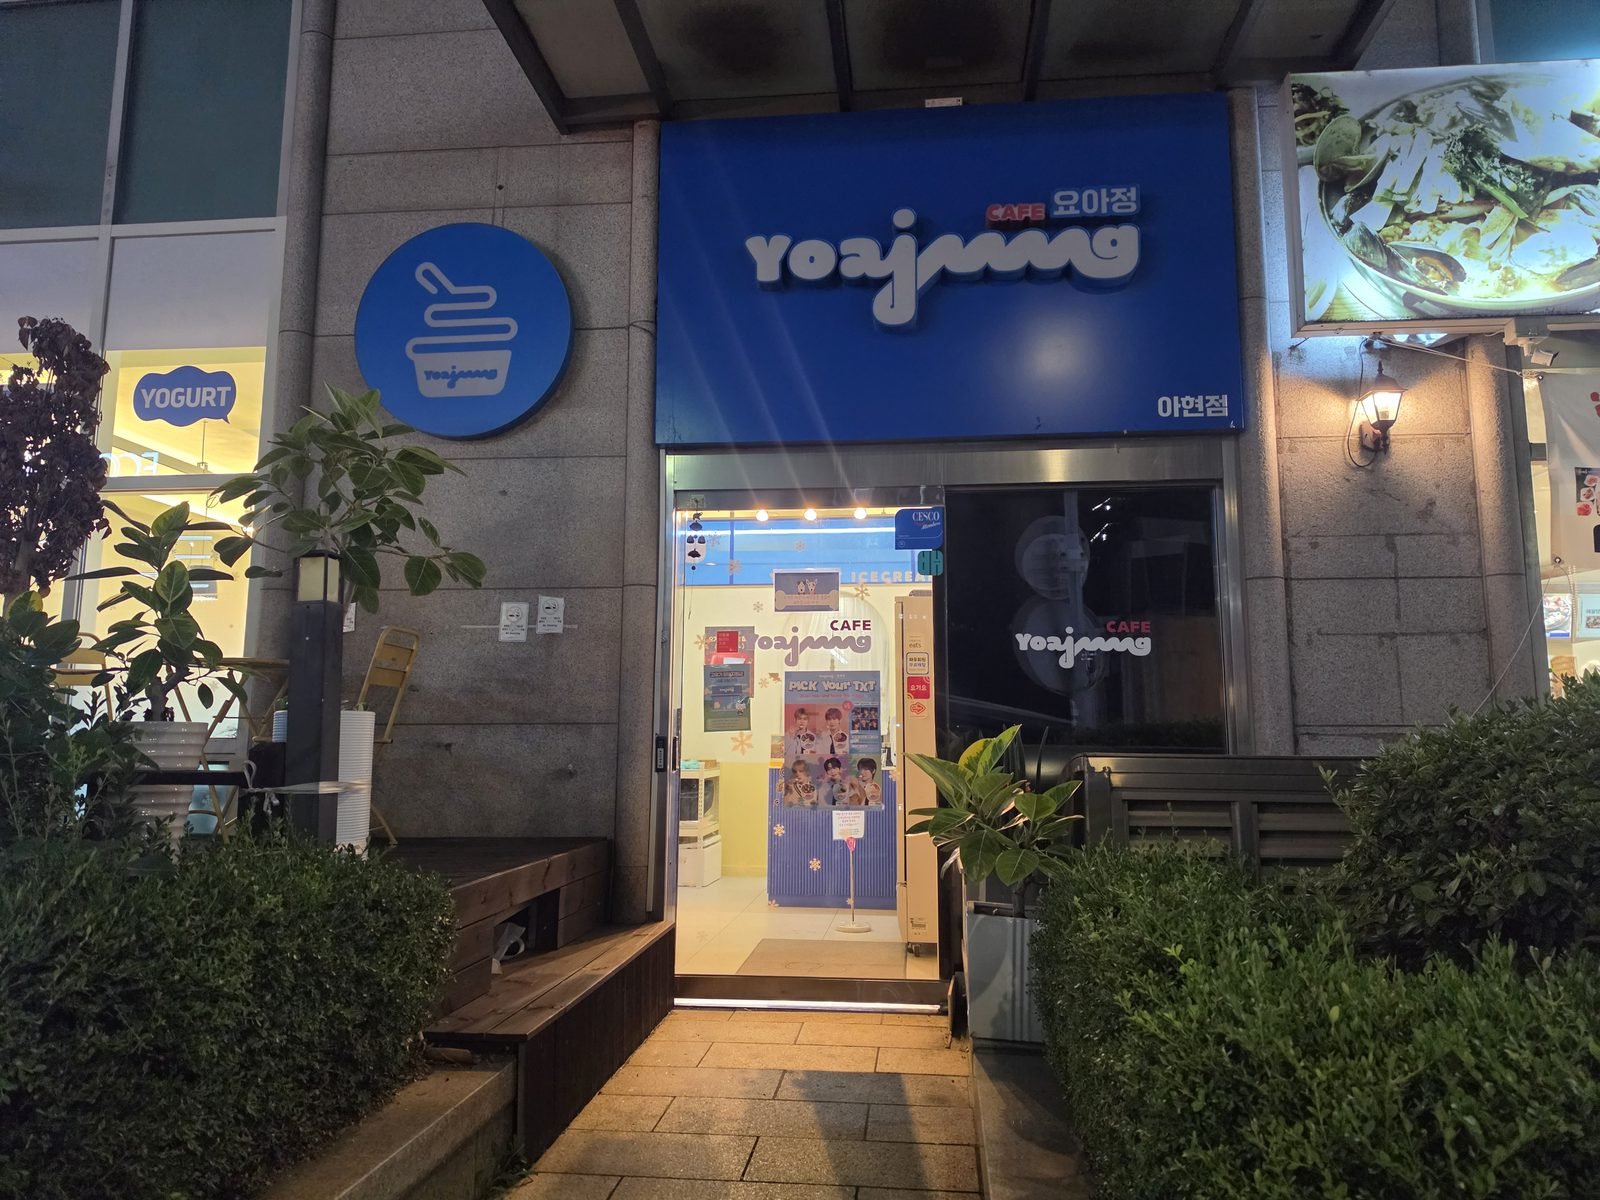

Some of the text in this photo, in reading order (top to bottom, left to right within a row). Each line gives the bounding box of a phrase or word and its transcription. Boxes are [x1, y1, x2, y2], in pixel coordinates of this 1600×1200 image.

[987, 186, 1138, 222] CAFE 요아정
[141, 386, 231, 409] YOGURT
[1158, 394, 1228, 418] 아현점
[912, 511, 940, 522] CESCO
[830, 620, 872, 631] CAFE
[1106, 620, 1151, 633] CAFE
[853, 680, 876, 692] TXT
